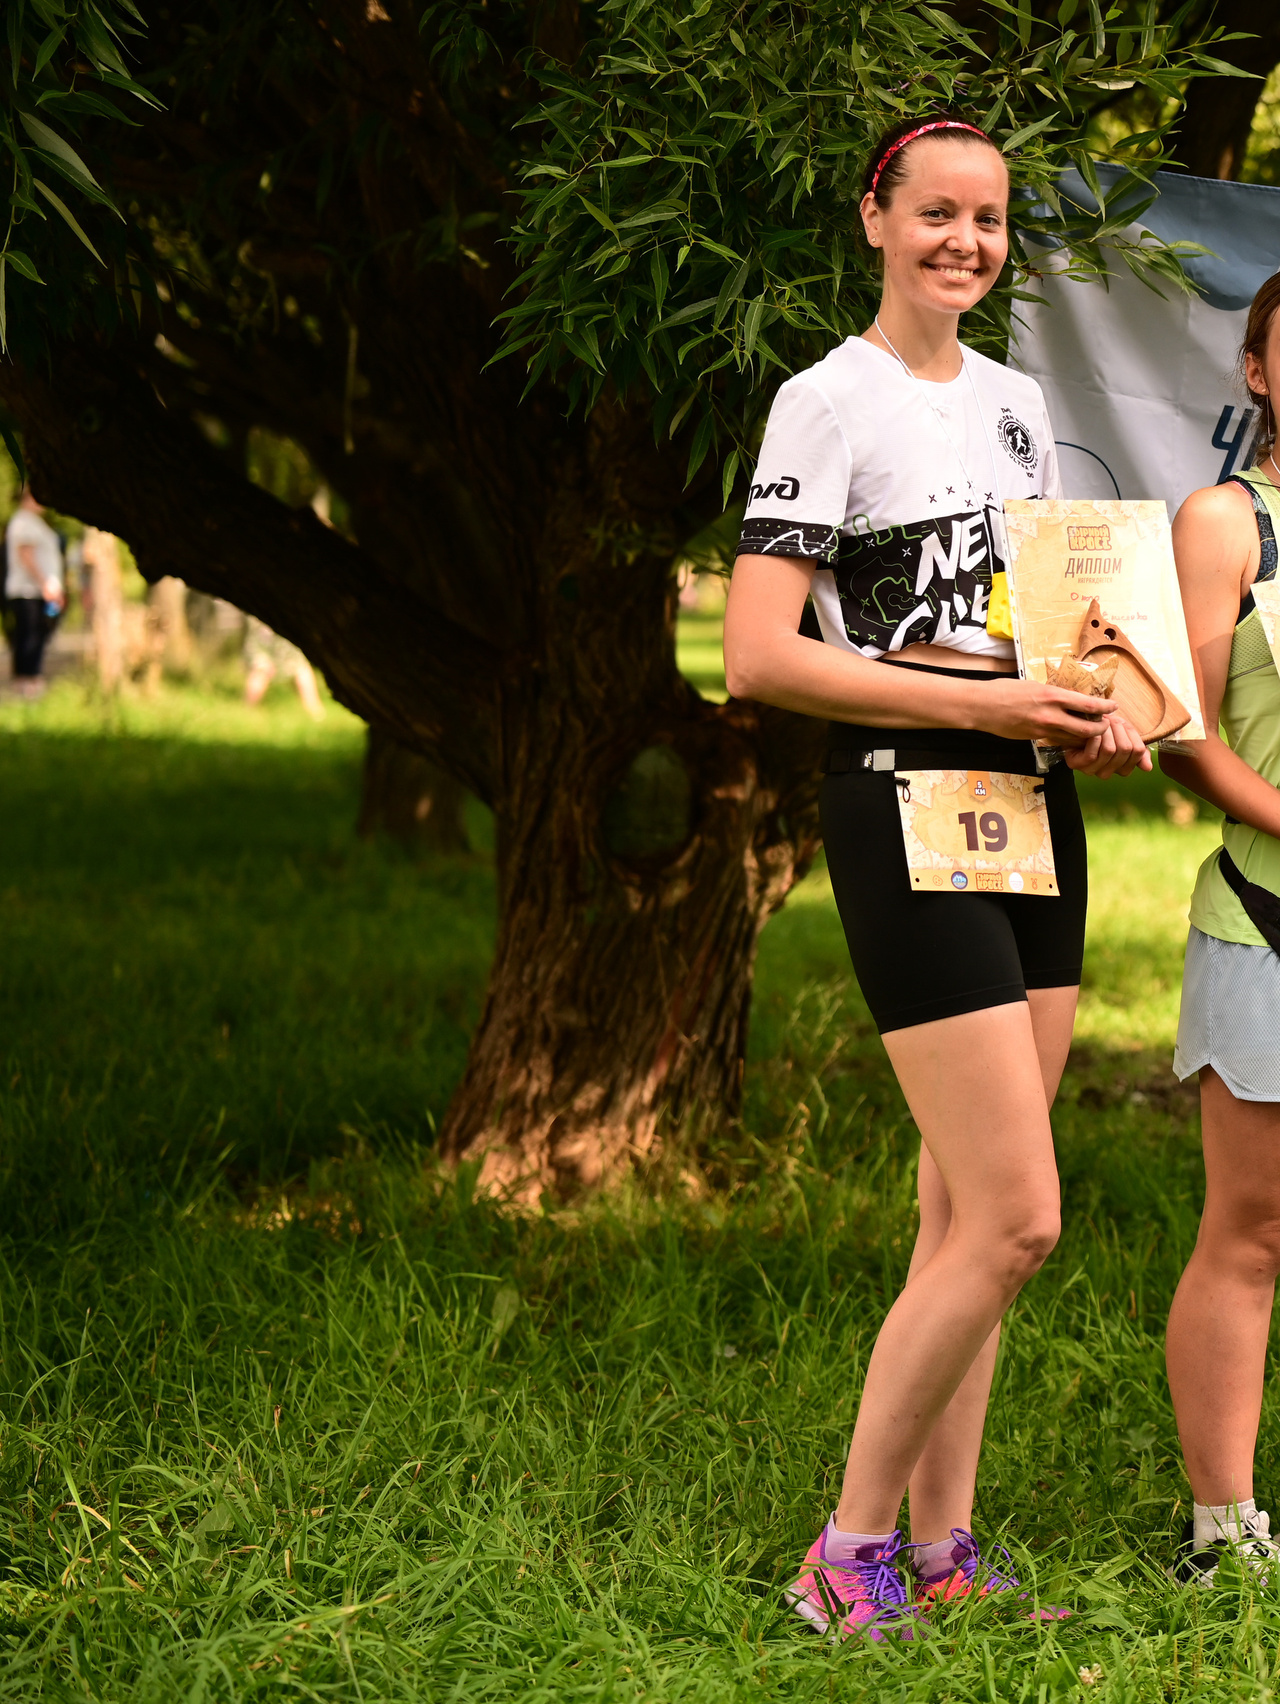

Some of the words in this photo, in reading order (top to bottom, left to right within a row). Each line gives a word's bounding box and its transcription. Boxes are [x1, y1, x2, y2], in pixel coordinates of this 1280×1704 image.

[1065, 558, 1122, 578] ДИПЛОМ
[976, 781, 983, 789] 5
[958, 811, 1008, 853] 19
